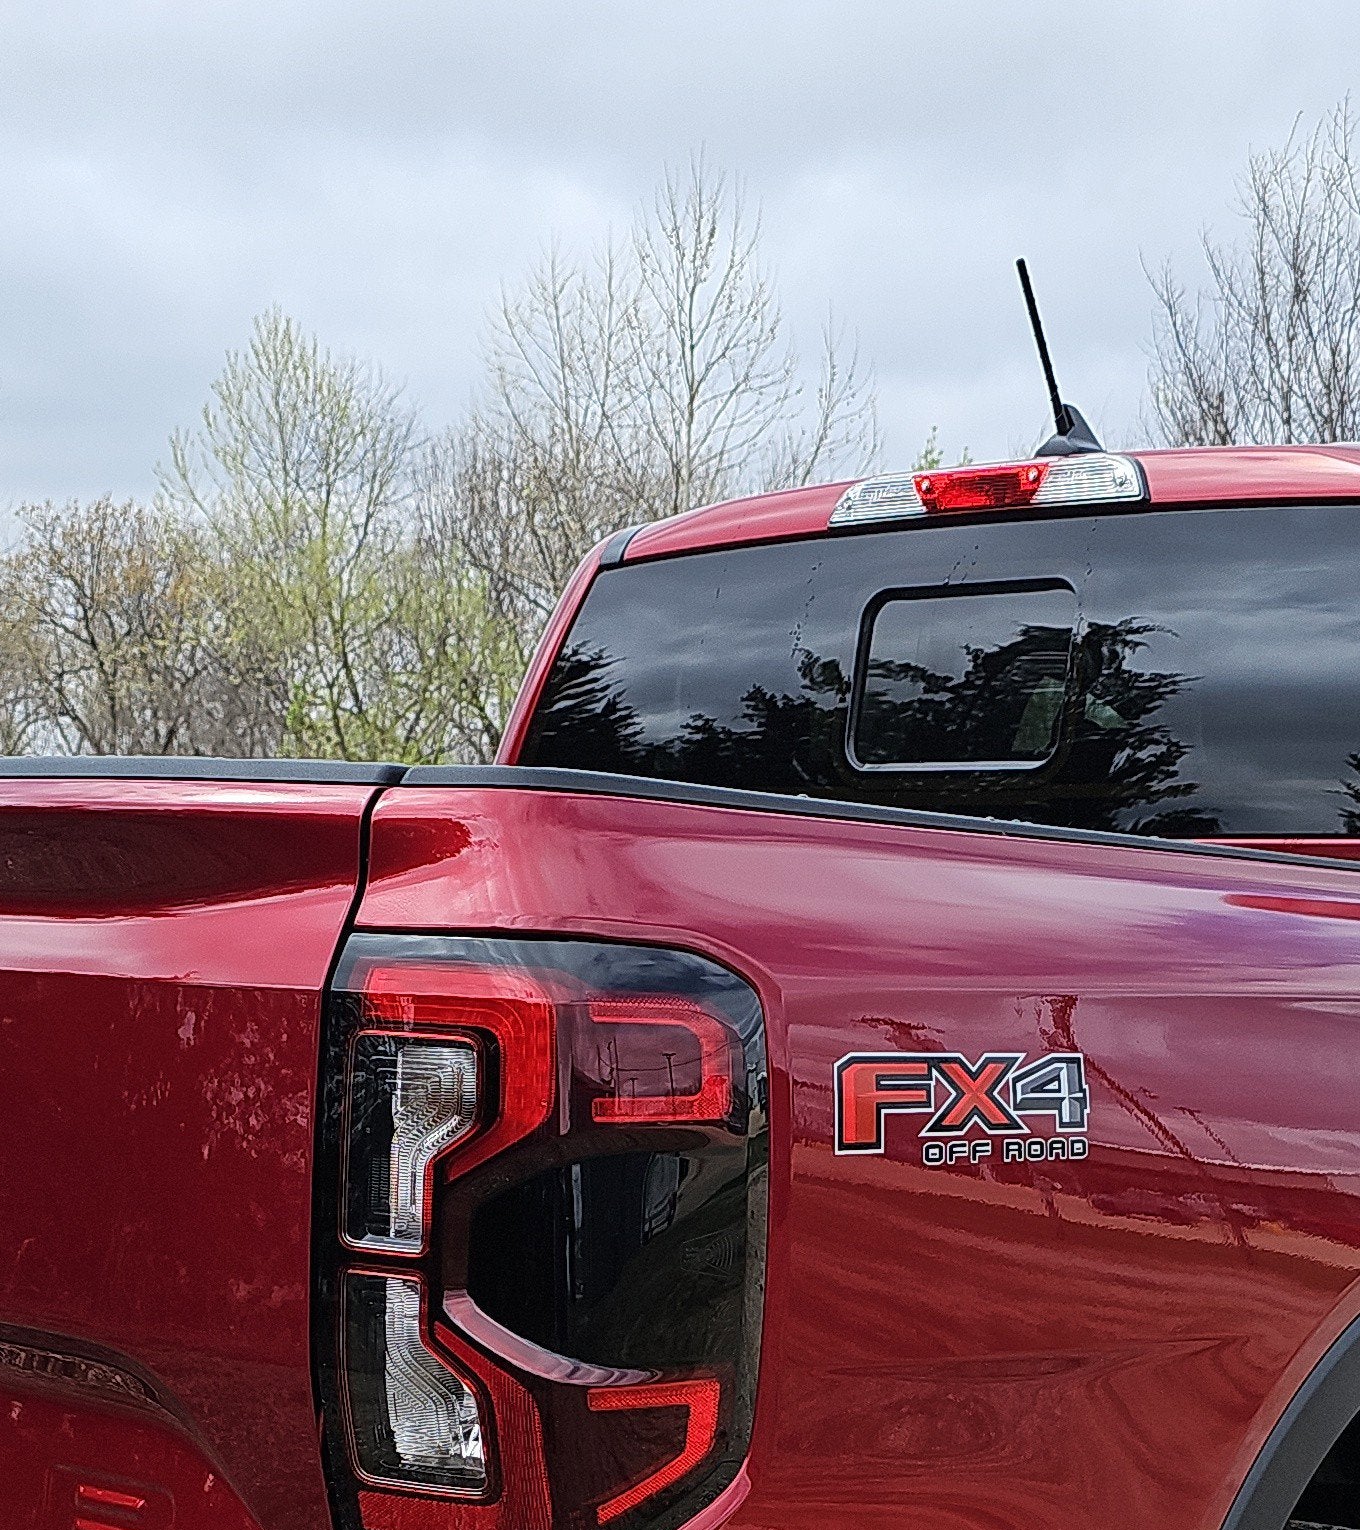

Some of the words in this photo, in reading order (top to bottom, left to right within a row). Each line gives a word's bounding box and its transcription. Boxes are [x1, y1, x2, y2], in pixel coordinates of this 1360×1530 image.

[833, 1052, 1090, 1155] FX4
[922, 1138, 992, 1165] OFF
[1003, 1137, 1089, 1163] ROAD
